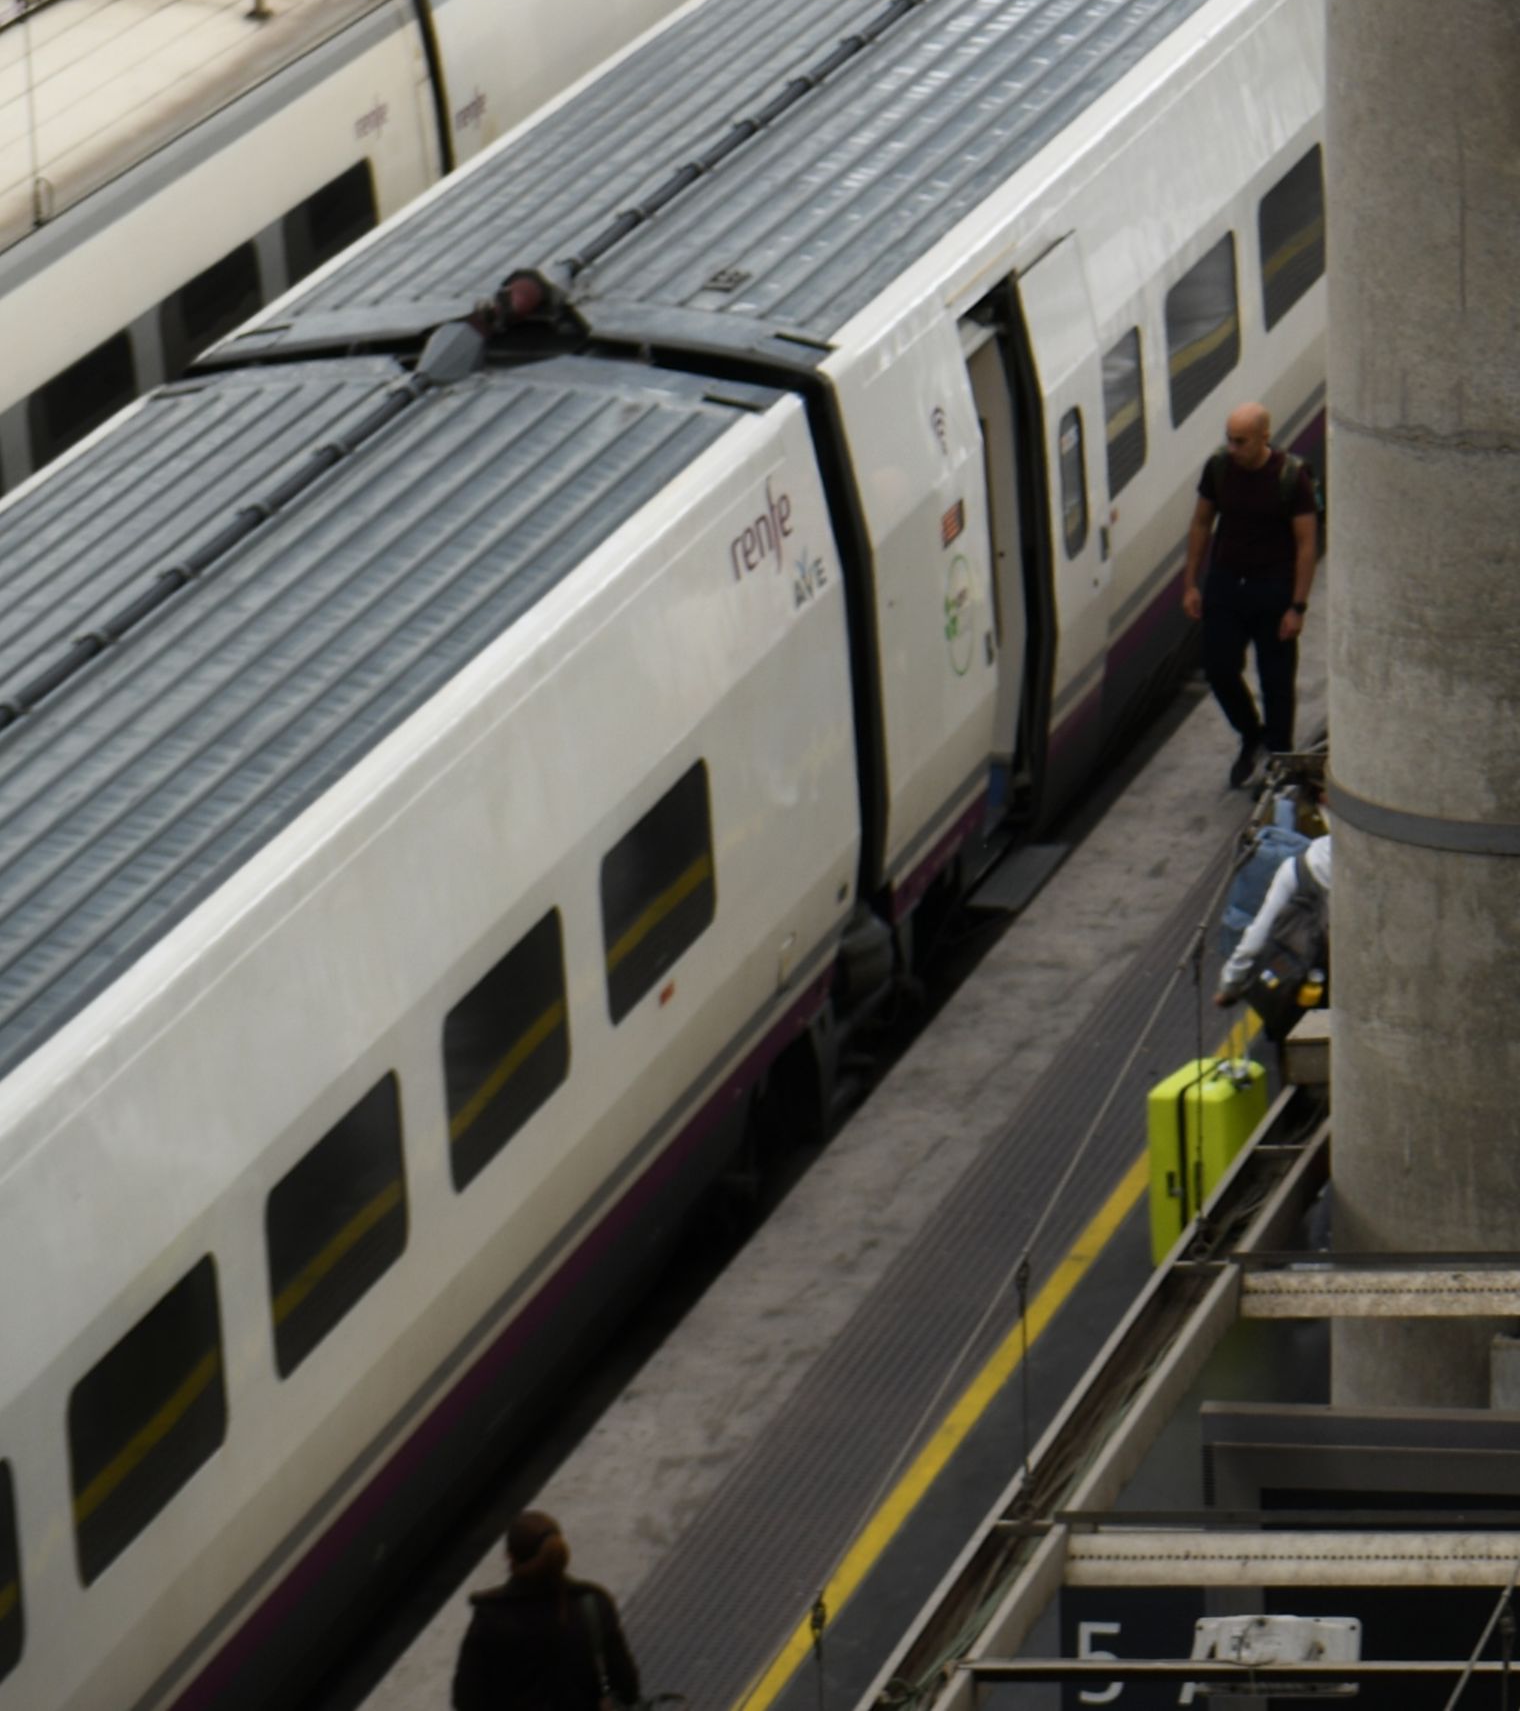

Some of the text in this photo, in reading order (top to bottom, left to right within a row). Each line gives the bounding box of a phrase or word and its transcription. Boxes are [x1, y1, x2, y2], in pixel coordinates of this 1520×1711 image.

[729, 475, 794, 583] renfe
[793, 550, 828, 610] AVE
[1078, 1621, 1125, 1704] 5
